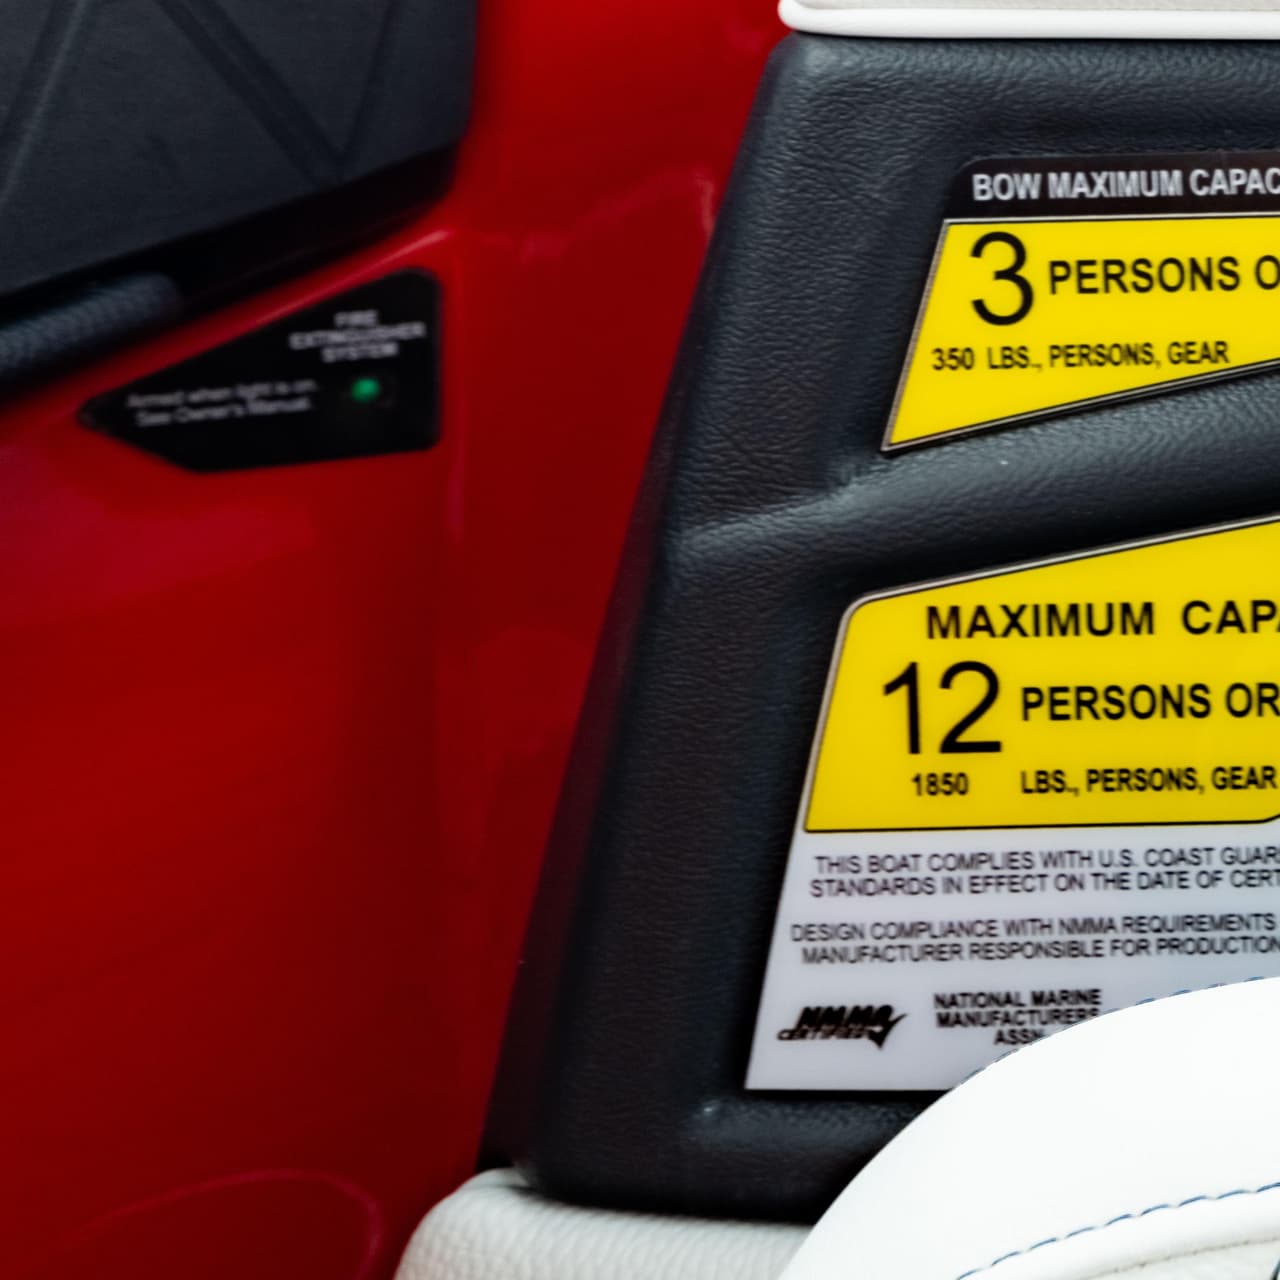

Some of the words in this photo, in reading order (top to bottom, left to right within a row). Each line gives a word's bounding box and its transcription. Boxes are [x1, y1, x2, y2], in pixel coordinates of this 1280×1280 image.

[972, 172, 1043, 202] BOW
[1049, 169, 1183, 198] MAXIMUM
[970, 231, 1034, 326] 3
[1049, 256, 1240, 294] PERSONS
[932, 348, 974, 371] 350
[1050, 344, 1160, 369] PERSONS,
[1168, 340, 1229, 365] GEAR
[926, 603, 1155, 639] MAXIMUM
[882, 661, 1002, 755] 12
[1022, 683, 1210, 722] PERSONS
[1226, 682, 1280, 718] OR
[912, 773, 969, 797] 1850
[1086, 768, 1205, 795] PERSONS,
[1212, 766, 1278, 791] GEAR
[814, 855, 860, 874] THIS
[868, 854, 922, 872] BOAT
[928, 851, 1035, 871] COMPLIES
[1040, 850, 1093, 869] WITH
[1099, 849, 1137, 868] U.S.
[1144, 847, 1215, 867] COAST
[810, 877, 936, 898] STANDARDS
[942, 876, 962, 895] IN
[970, 874, 1048, 894] EFFECT
[1054, 873, 1084, 892] ON
[1091, 872, 1131, 891] THE
[1136, 871, 1190, 890] DATE
[1196, 870, 1223, 889] OF
[791, 923, 865, 942] DESIGN
[870, 919, 999, 940] COMPLIANCE
[1004, 919, 1052, 937] WITH
[1060, 917, 1116, 935] NMMA
[1122, 913, 1275, 934] REQUIREMENTS
[802, 943, 964, 964] MANUFACTURER
[969, 939, 1104, 960] RESPONSIBLE
[1110, 938, 1150, 957] FOR
[933, 992, 1024, 1010] NATIONAL
[1030, 988, 1102, 1007] MARINE
